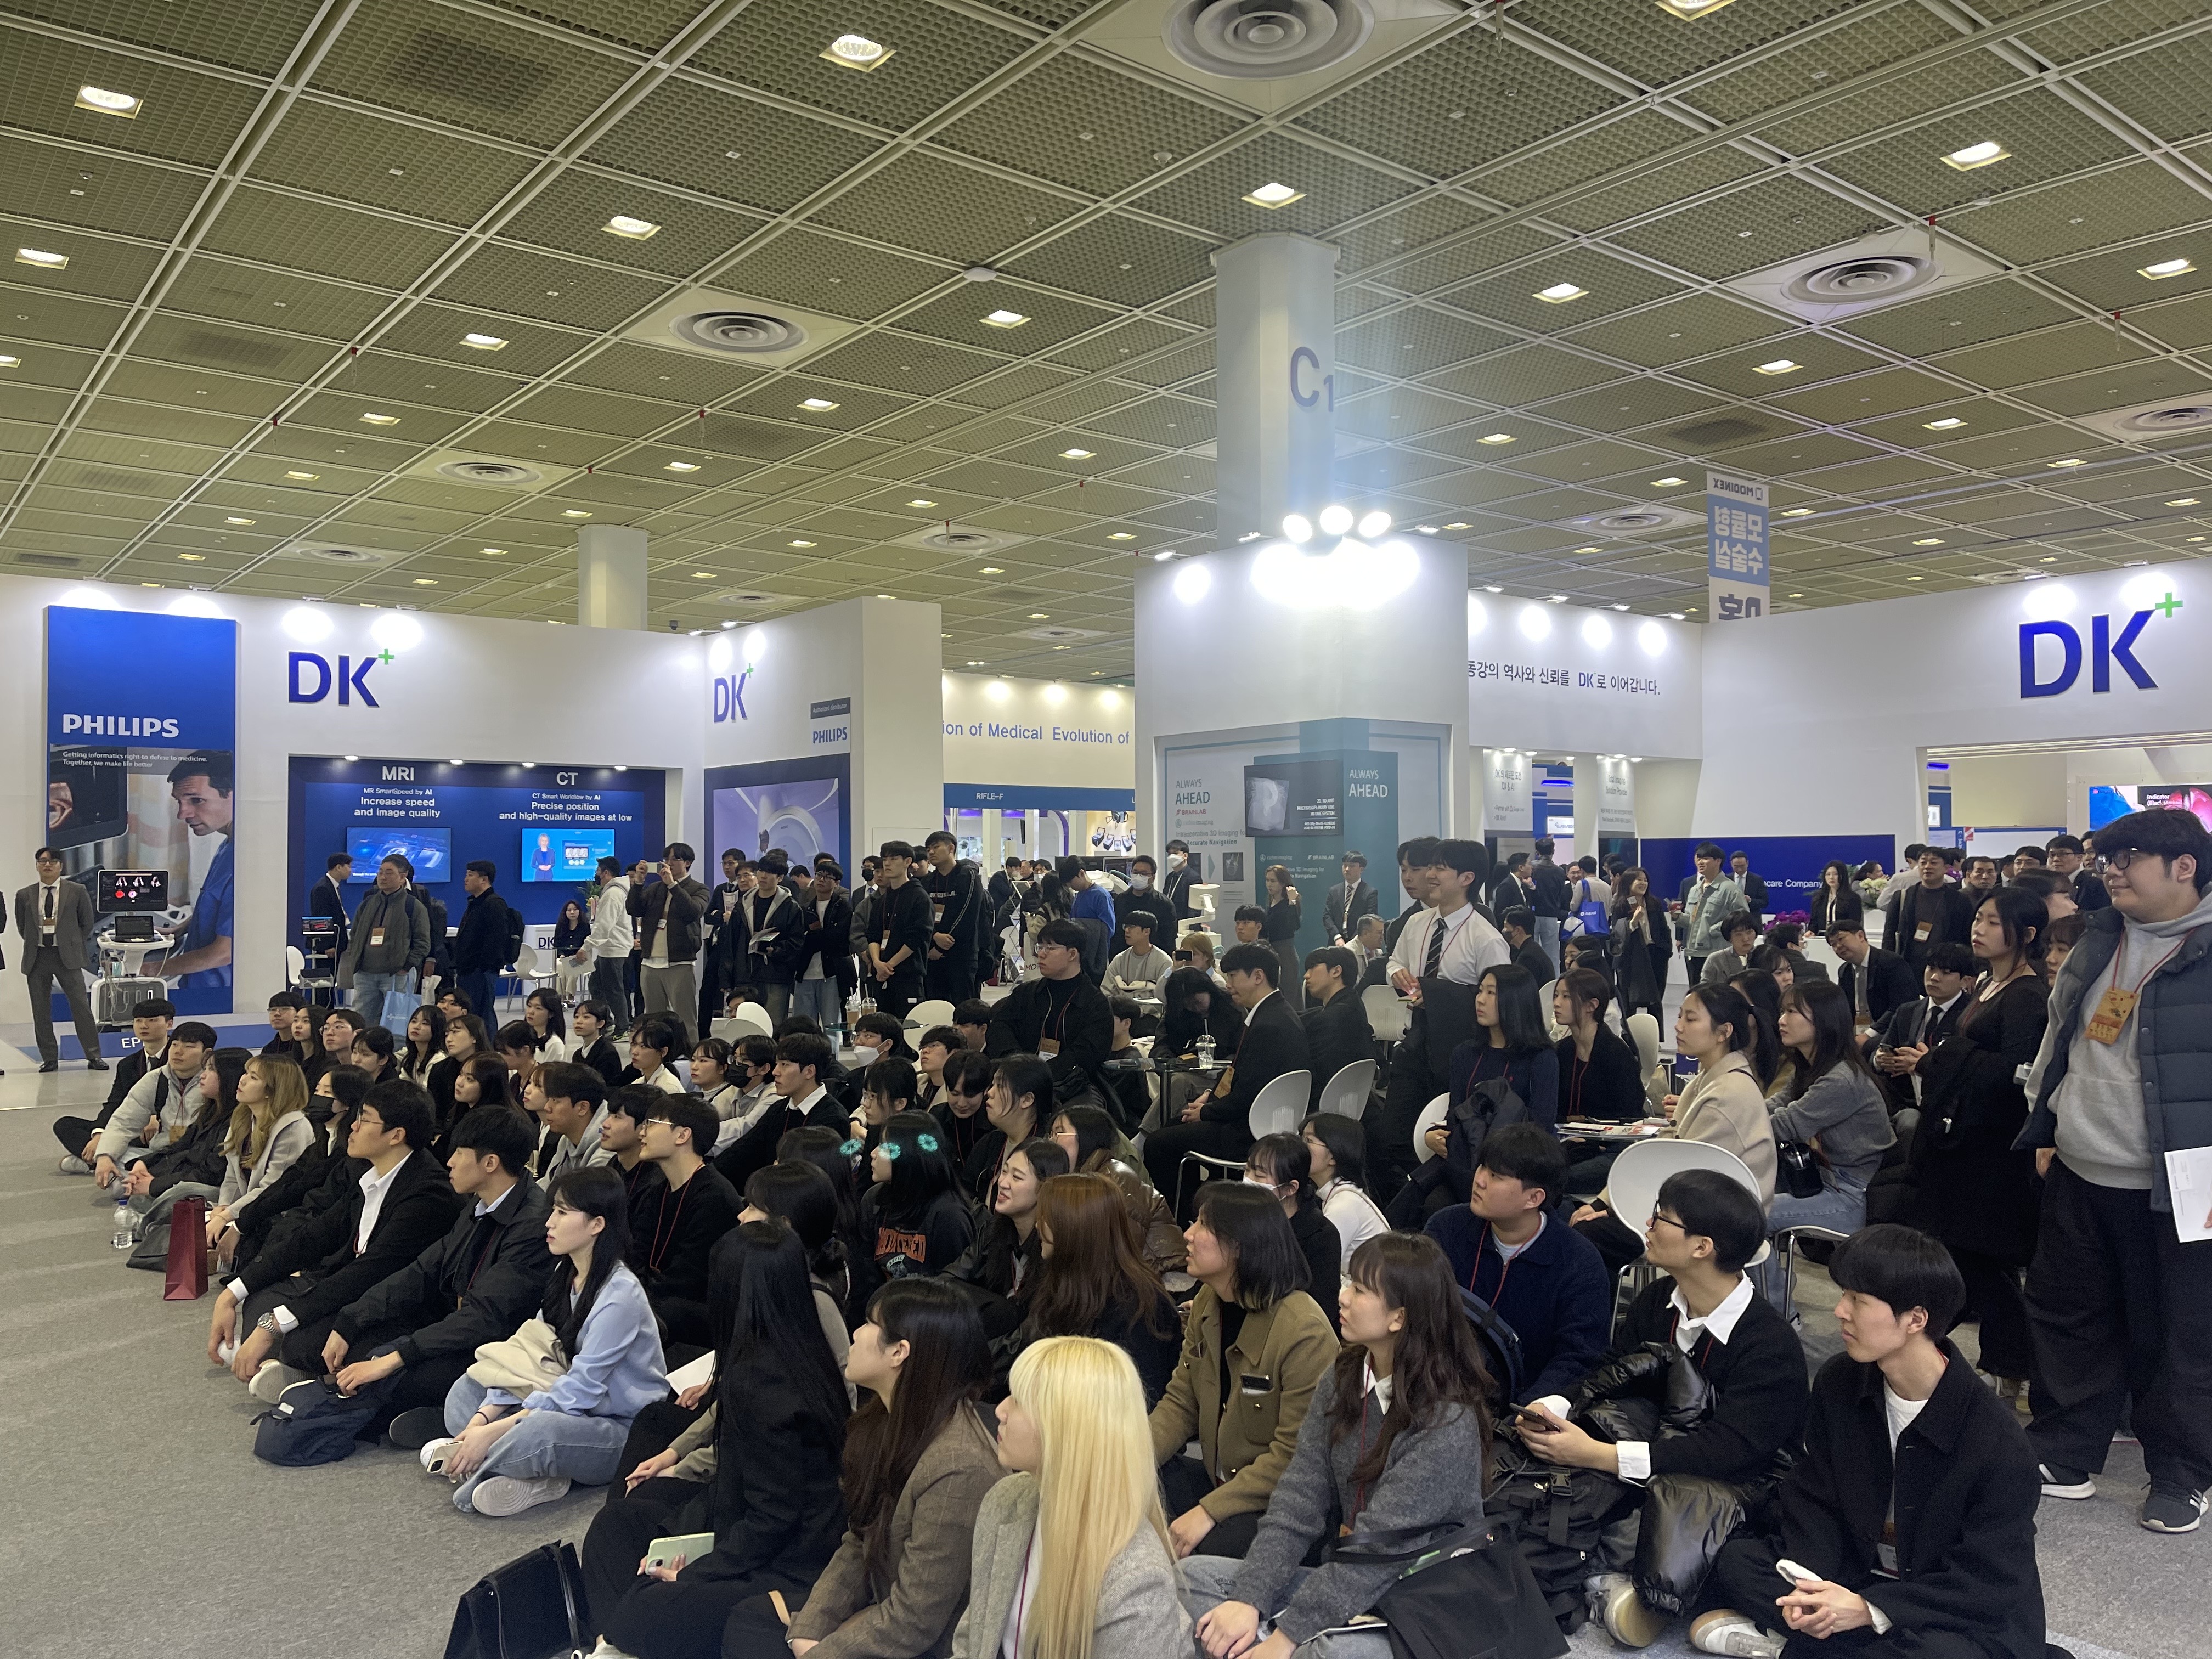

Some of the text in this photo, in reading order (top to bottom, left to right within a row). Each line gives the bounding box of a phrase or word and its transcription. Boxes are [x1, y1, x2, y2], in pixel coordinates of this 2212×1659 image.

[1503, 663, 1536, 683] 역사와
[1539, 668, 1570, 686] 신뢰를
[1610, 675, 1660, 695] 이어갑니다.
[63, 714, 179, 738] PHILIPS
[812, 726, 848, 744] PHILIPS
[969, 723, 983, 736] of
[988, 723, 1042, 740] Medical
[1053, 727, 1113, 743] Evolution
[1118, 731, 1130, 744] of
[382, 766, 414, 781] MRI
[556, 772, 578, 785] CT
[1349, 769, 1379, 780] ALWAYS
[1176, 778, 1202, 788] ALWAYS
[976, 792, 1003, 800] RIFLE-F
[1349, 783, 1388, 798] AHEAD
[360, 797, 435, 806] Increase speed
[1175, 792, 1210, 805] AHEAD
[531, 802, 599, 811] Precise position
[354, 808, 441, 818] and image quality
[499, 811, 516, 820] and
[519, 812, 572, 821] high-quality
[575, 812, 605, 821] images
[1785, 879, 1824, 889] Company
